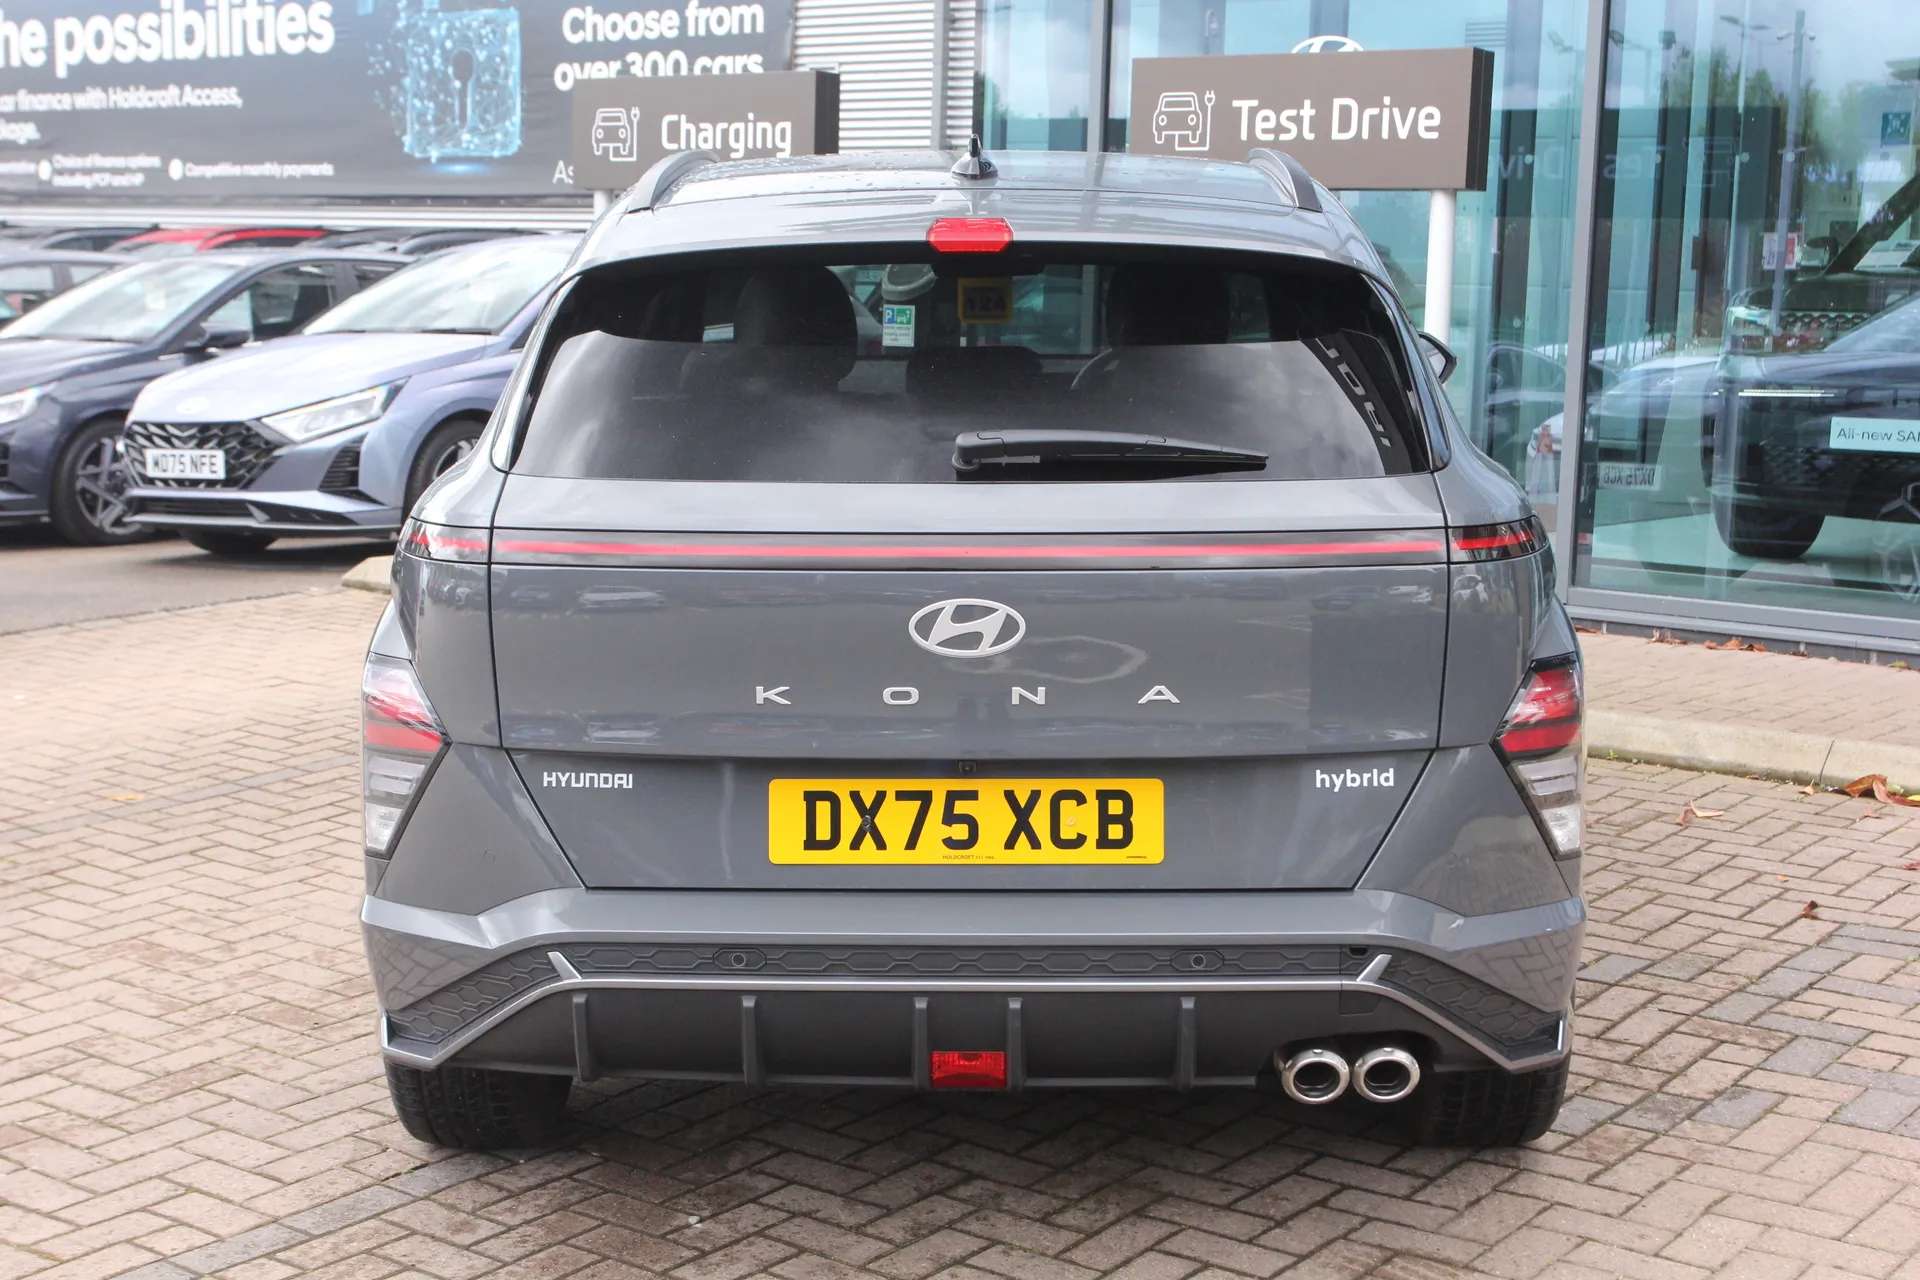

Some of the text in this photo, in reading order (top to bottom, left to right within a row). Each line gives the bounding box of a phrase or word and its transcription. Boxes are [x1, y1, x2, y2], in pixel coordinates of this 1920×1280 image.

[562, 0, 764, 44] Choose from
[54, 0, 336, 79] possibilities
[73, 86, 107, 110] with
[1232, 96, 1441, 141] Test Drive
[661, 113, 792, 159] Charging
[1836, 427, 1893, 441] All-new
[190, 454, 217, 474] NFE
[755, 685, 1181, 705] KONA
[543, 771, 633, 789] HYUNDAI
[1315, 768, 1395, 792] hybrid
[803, 789, 1134, 851] DX75 XCB
